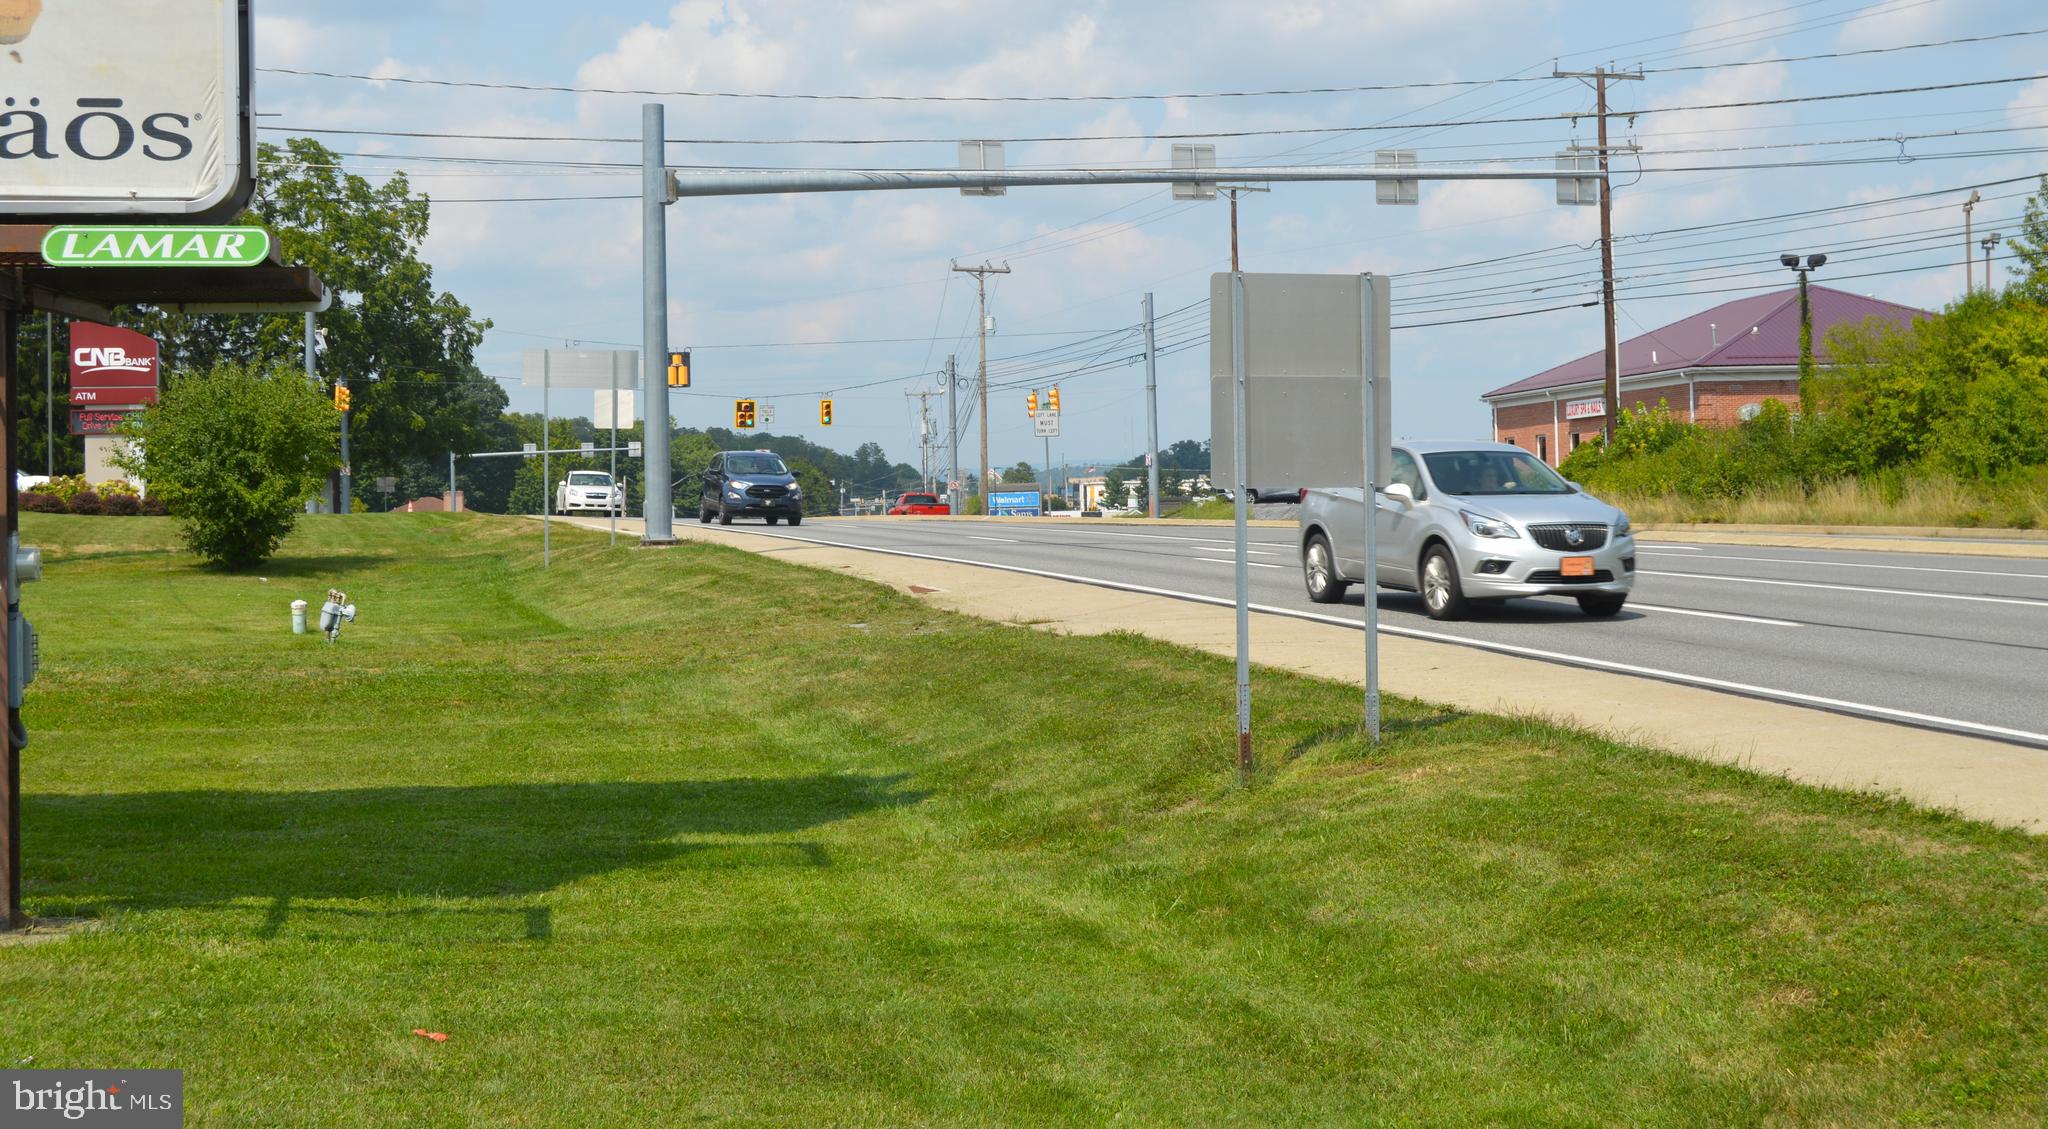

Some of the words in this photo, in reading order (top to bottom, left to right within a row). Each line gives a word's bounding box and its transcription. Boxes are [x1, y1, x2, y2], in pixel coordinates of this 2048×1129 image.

[61, 233, 246, 259] LAMAR
[74, 347, 126, 367] CNB
[125, 357, 152, 366] BANK
[75, 392, 97, 401] ATM
[80, 413, 93, 421] Full
[95, 413, 123, 421] Service
[992, 496, 1025, 504] Walmart
